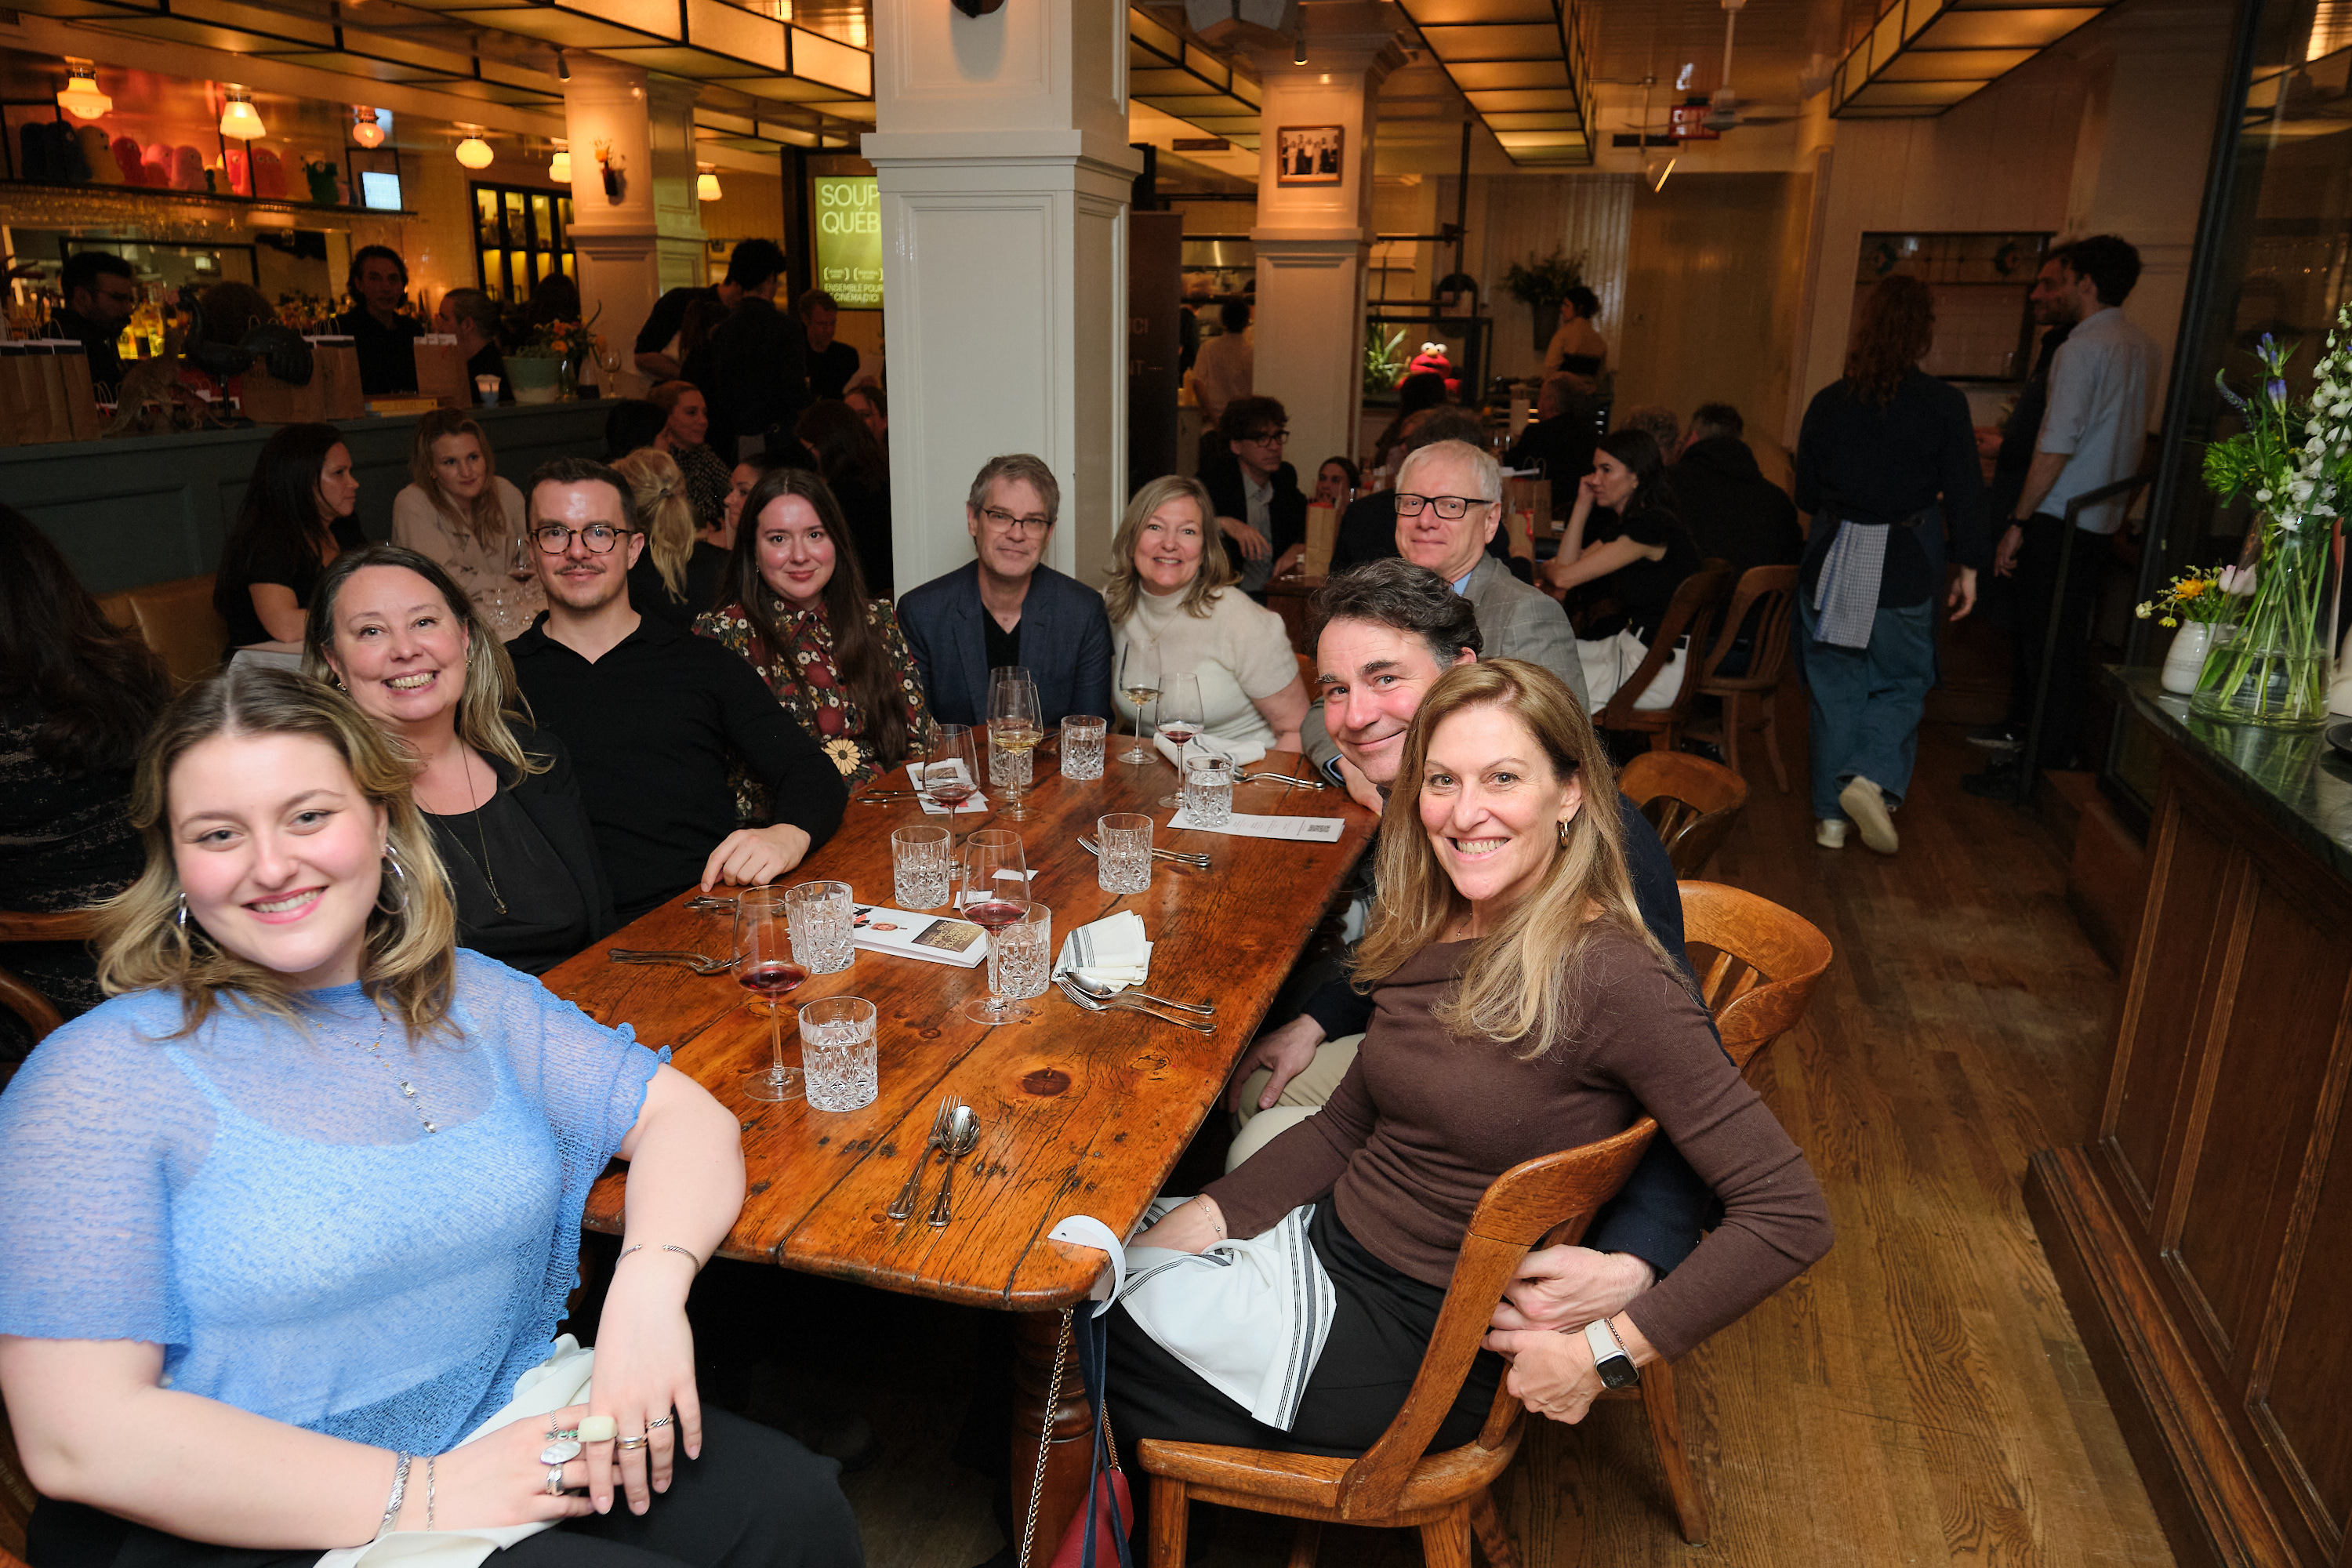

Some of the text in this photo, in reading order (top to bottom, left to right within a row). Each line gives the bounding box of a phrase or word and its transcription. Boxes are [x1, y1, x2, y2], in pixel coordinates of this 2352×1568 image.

[821, 206, 881, 234] QUÉB
[824, 283, 862, 293] ENSEMBLE
[833, 292, 862, 303] CINÉMA
